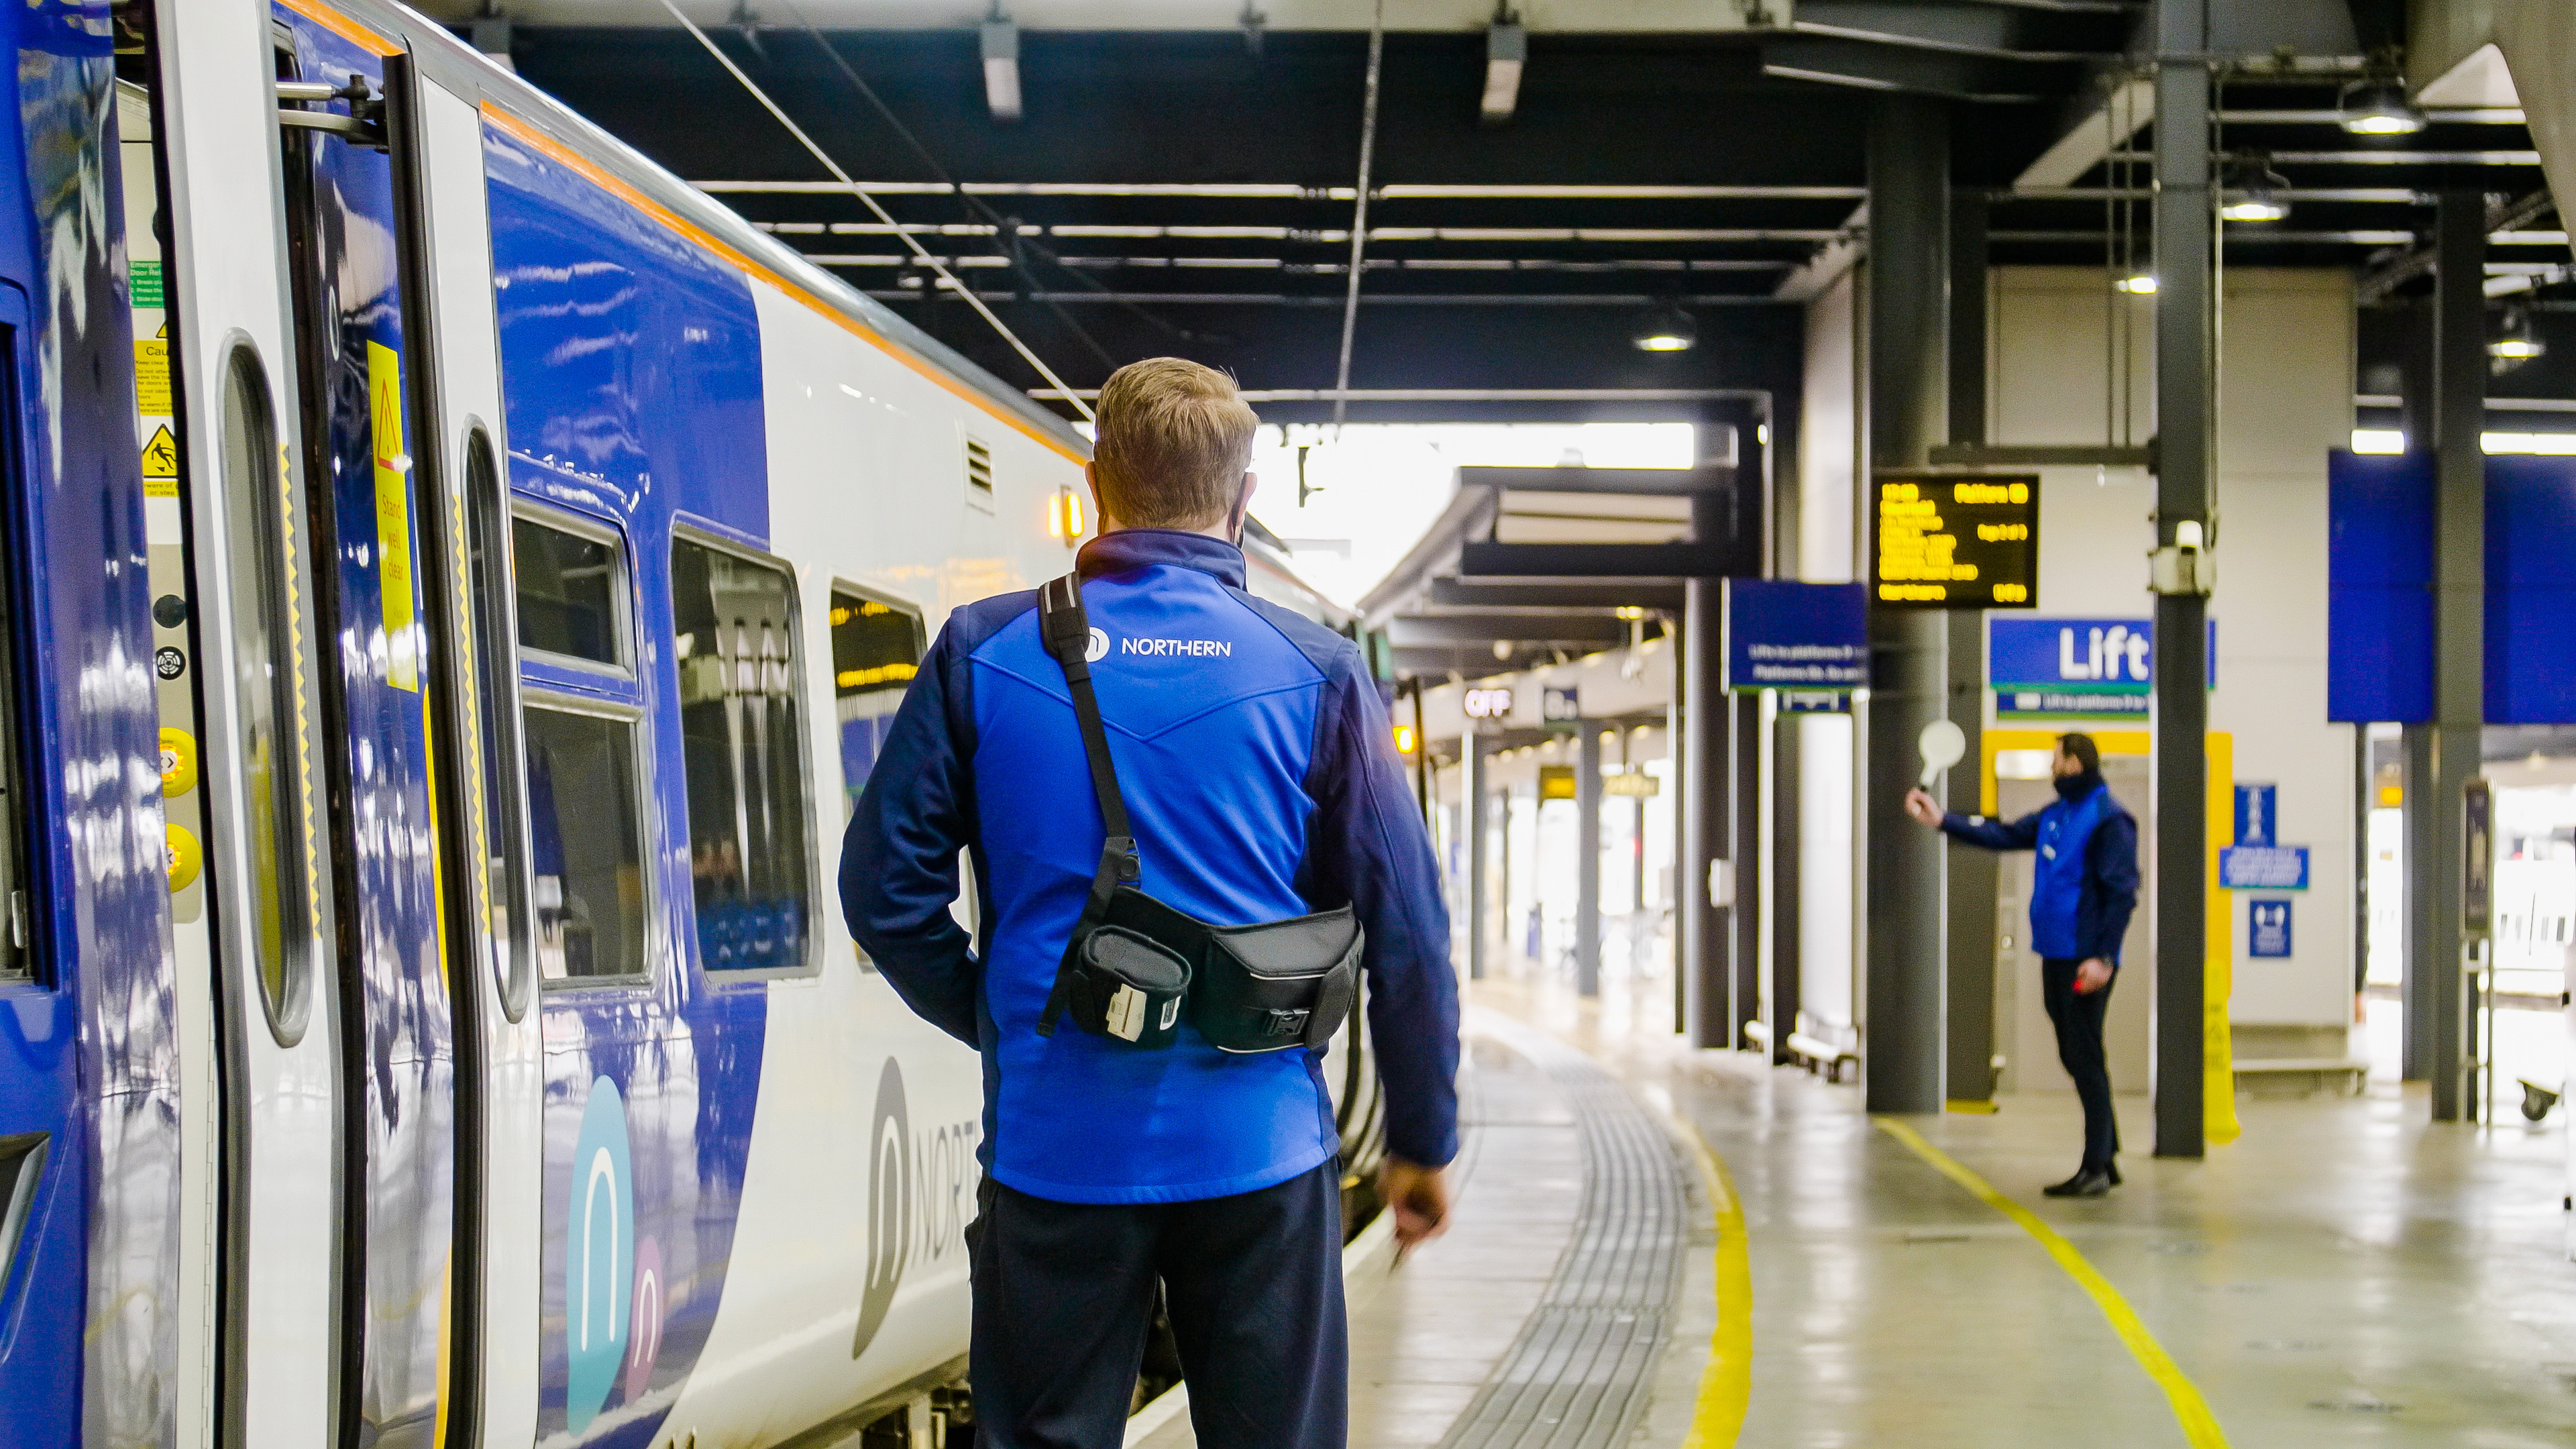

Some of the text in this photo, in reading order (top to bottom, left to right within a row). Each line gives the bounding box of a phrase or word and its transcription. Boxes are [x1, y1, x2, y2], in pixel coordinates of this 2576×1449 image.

[382, 494, 401, 519] Stand
[387, 529, 400, 550] well
[388, 557, 403, 582] clear
[1122, 637, 1232, 657] NORTHERN
[2059, 625, 2149, 681] Lift
